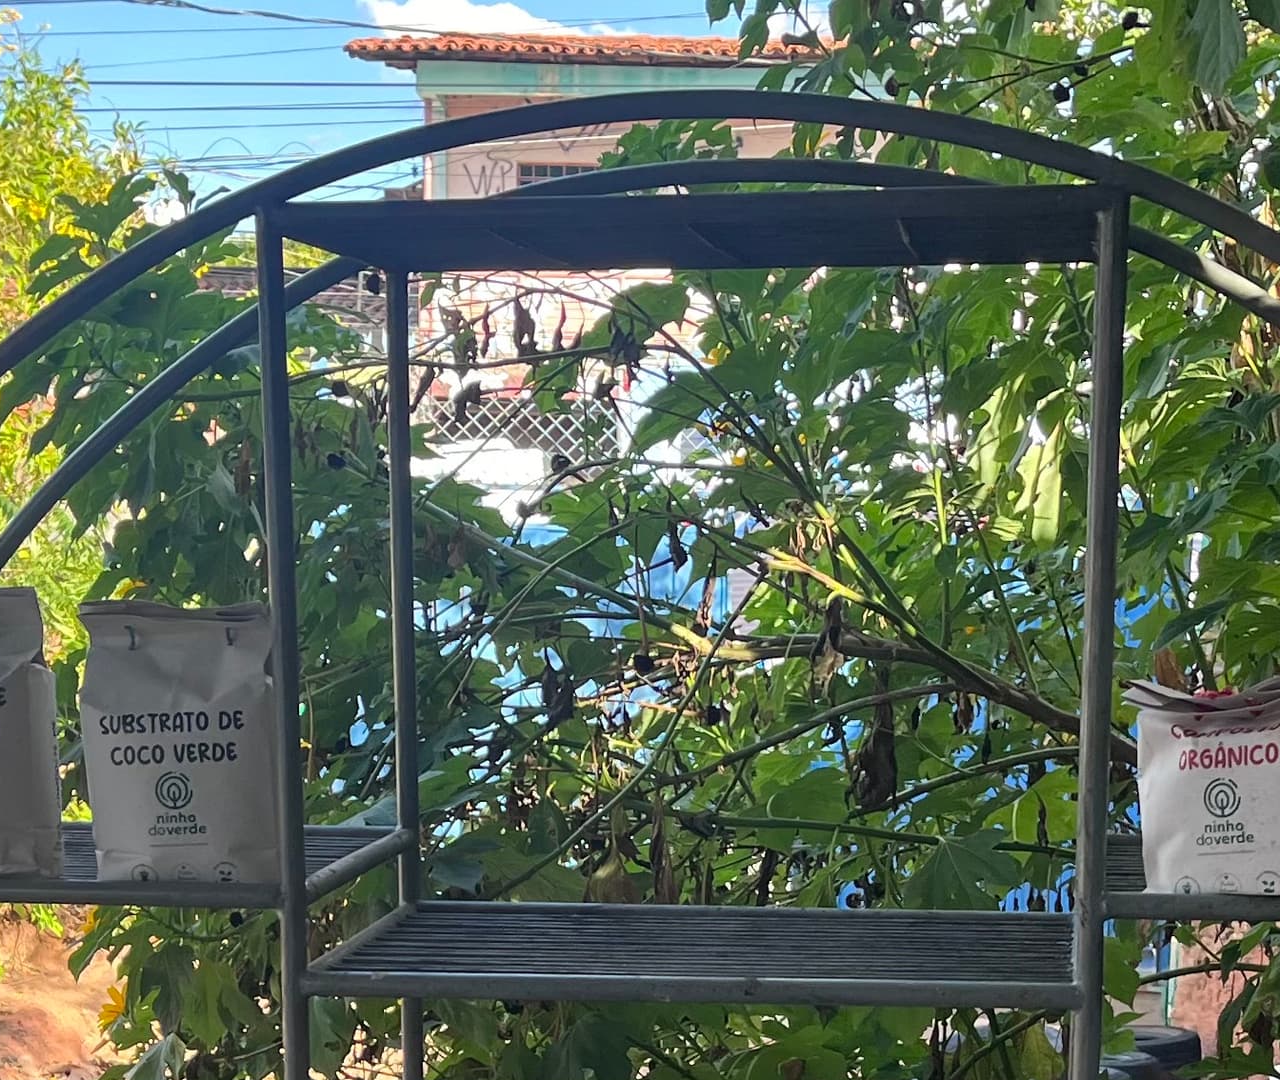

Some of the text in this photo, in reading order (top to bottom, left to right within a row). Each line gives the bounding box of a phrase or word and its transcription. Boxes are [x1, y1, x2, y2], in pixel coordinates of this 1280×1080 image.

[99, 710, 245, 735] SUBSTRATO DE
[110, 742, 238, 766] COCO VERDE
[1178, 741, 1280, 772] ORGÂNICO
[156, 812, 197, 824] ninho
[148, 823, 207, 837] doverde
[1204, 820, 1245, 833] ninho
[1196, 831, 1255, 847] doverde
